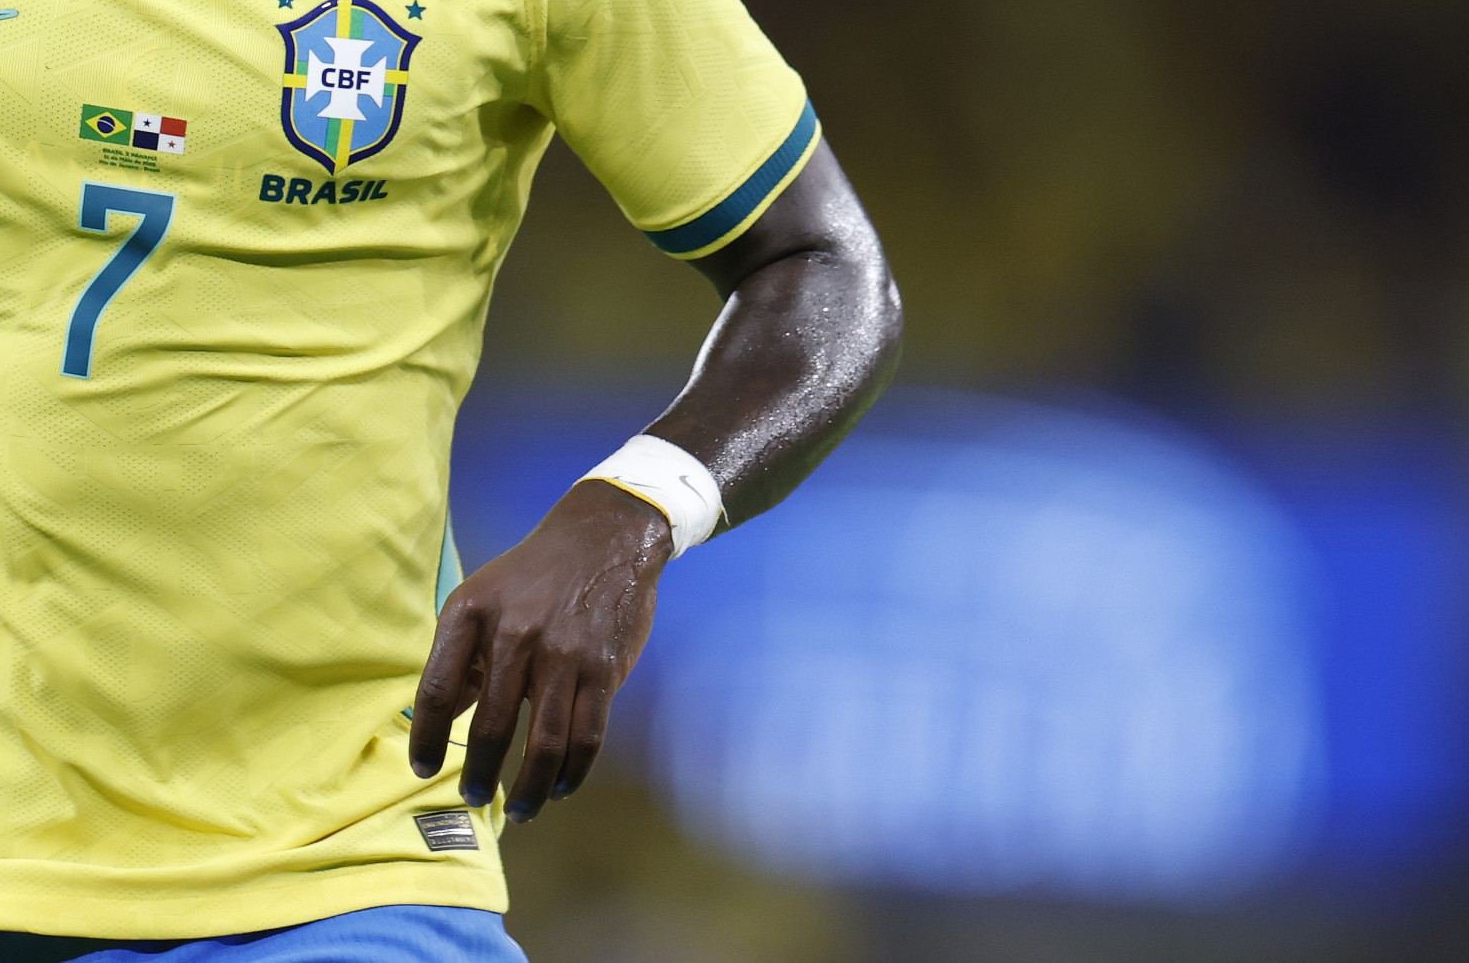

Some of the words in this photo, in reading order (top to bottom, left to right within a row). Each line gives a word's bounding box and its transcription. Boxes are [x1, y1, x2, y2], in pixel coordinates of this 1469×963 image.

[321, 68, 371, 90] CBF
[259, 174, 388, 204] BRASIL
[61, 181, 176, 380] 7
